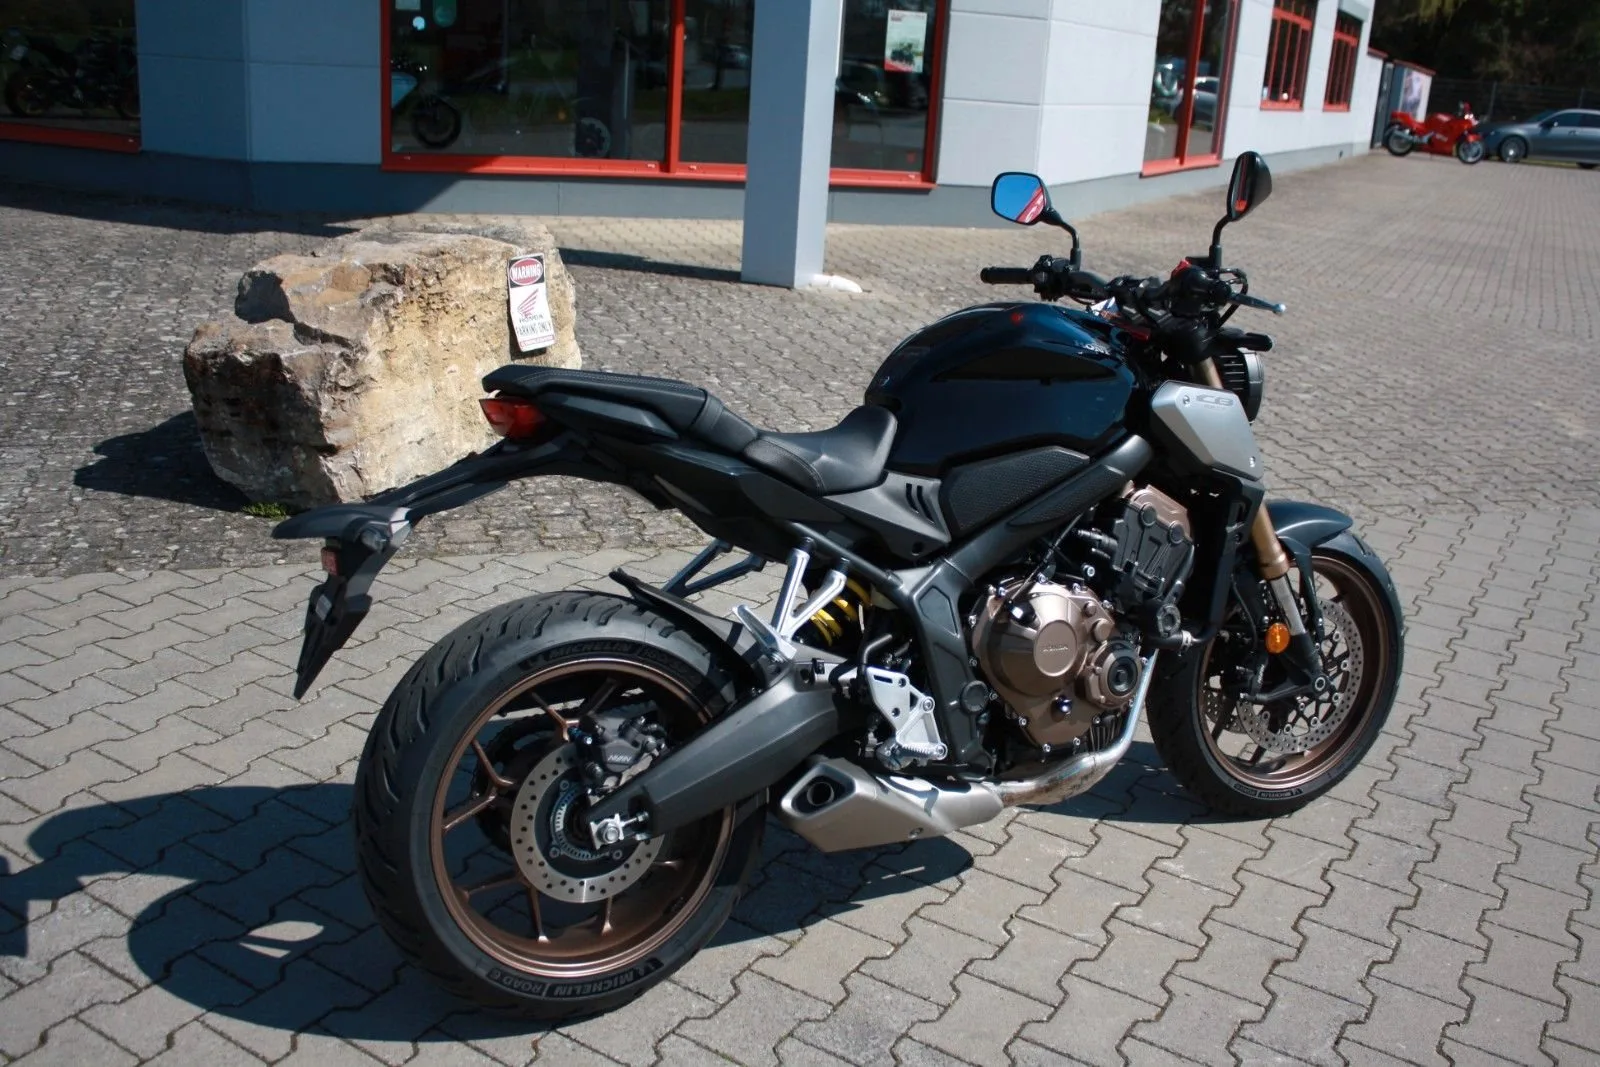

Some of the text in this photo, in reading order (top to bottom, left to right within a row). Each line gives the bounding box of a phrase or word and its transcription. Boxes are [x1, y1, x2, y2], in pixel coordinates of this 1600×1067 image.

[511, 264, 541, 280] WARNING
[503, 977, 543, 993] ROAD
[553, 969, 634, 997] MICHELIN
